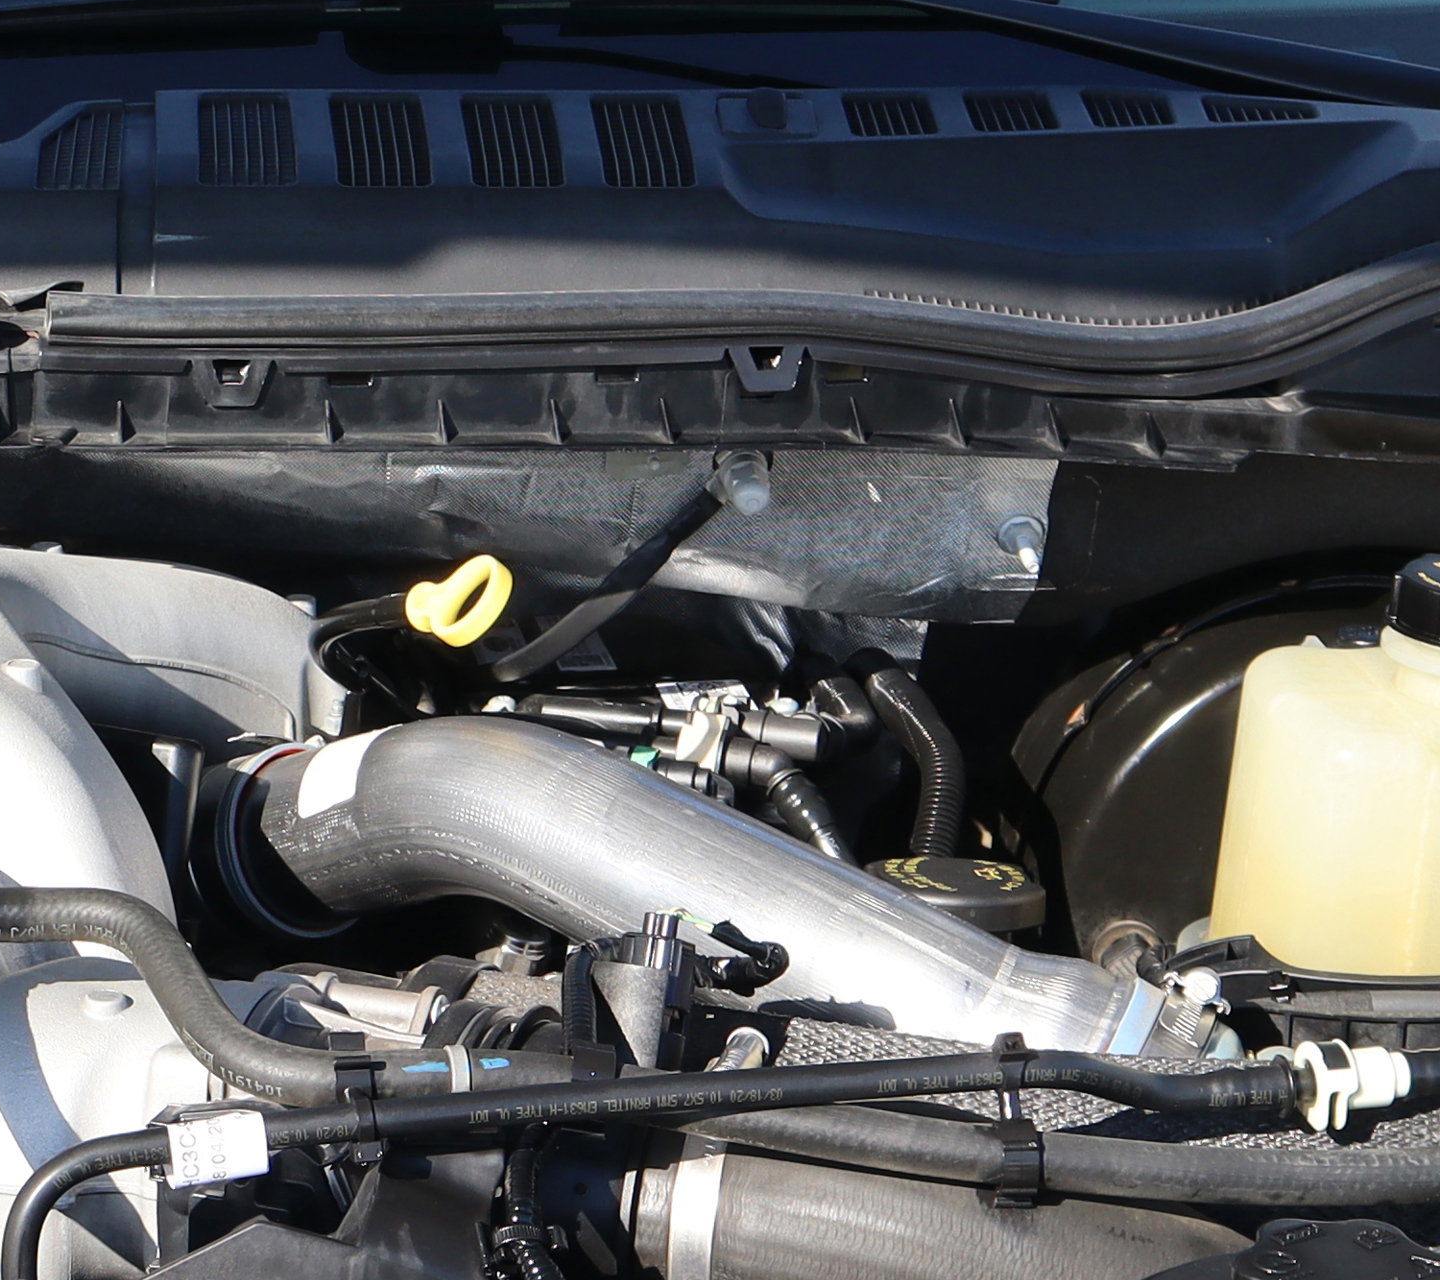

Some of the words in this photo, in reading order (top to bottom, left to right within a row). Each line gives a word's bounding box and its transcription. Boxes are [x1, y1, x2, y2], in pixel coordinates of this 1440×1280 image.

[219, 1066, 283, 1097] 1041911
[877, 1079, 897, 1093] DOT
[922, 1075, 949, 1090] TYPE
[730, 1087, 783, 1102] 03/18/20
[602, 1095, 651, 1112] ARNITEL
[468, 1109, 489, 1124] DOT
[516, 1104, 543, 1119] TYPE
